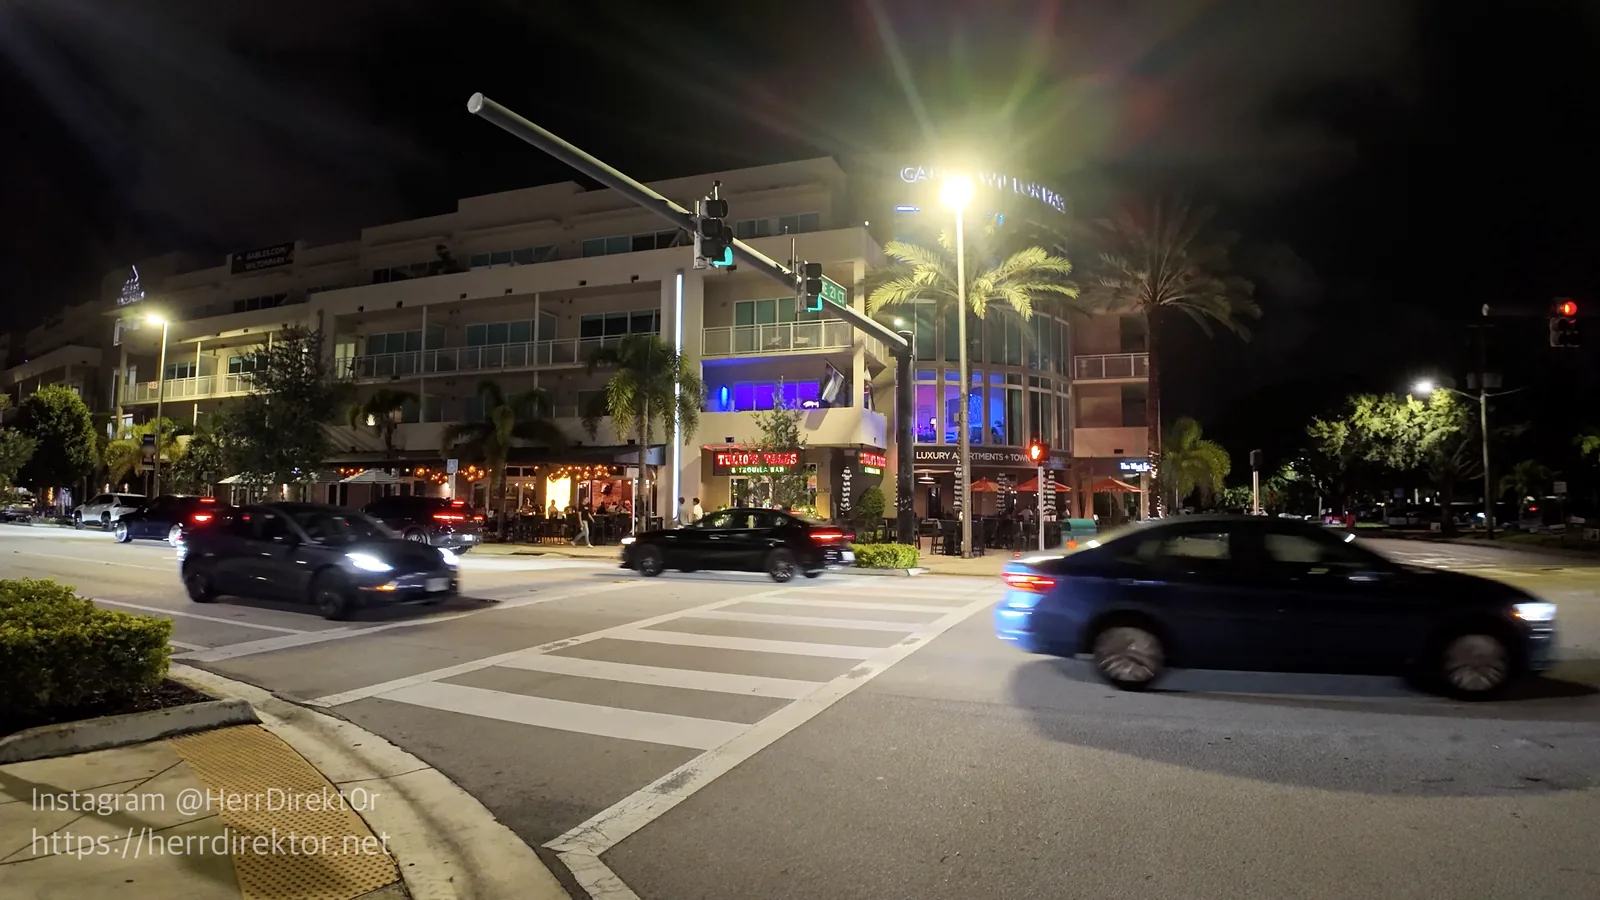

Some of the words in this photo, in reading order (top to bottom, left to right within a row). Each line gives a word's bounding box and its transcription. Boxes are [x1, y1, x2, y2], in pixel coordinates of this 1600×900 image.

[829, 285, 837, 300] 21
[837, 290, 846, 305] CT
[916, 451, 950, 460] LUXURY
[951, 452, 1004, 462] ARTMENTS
